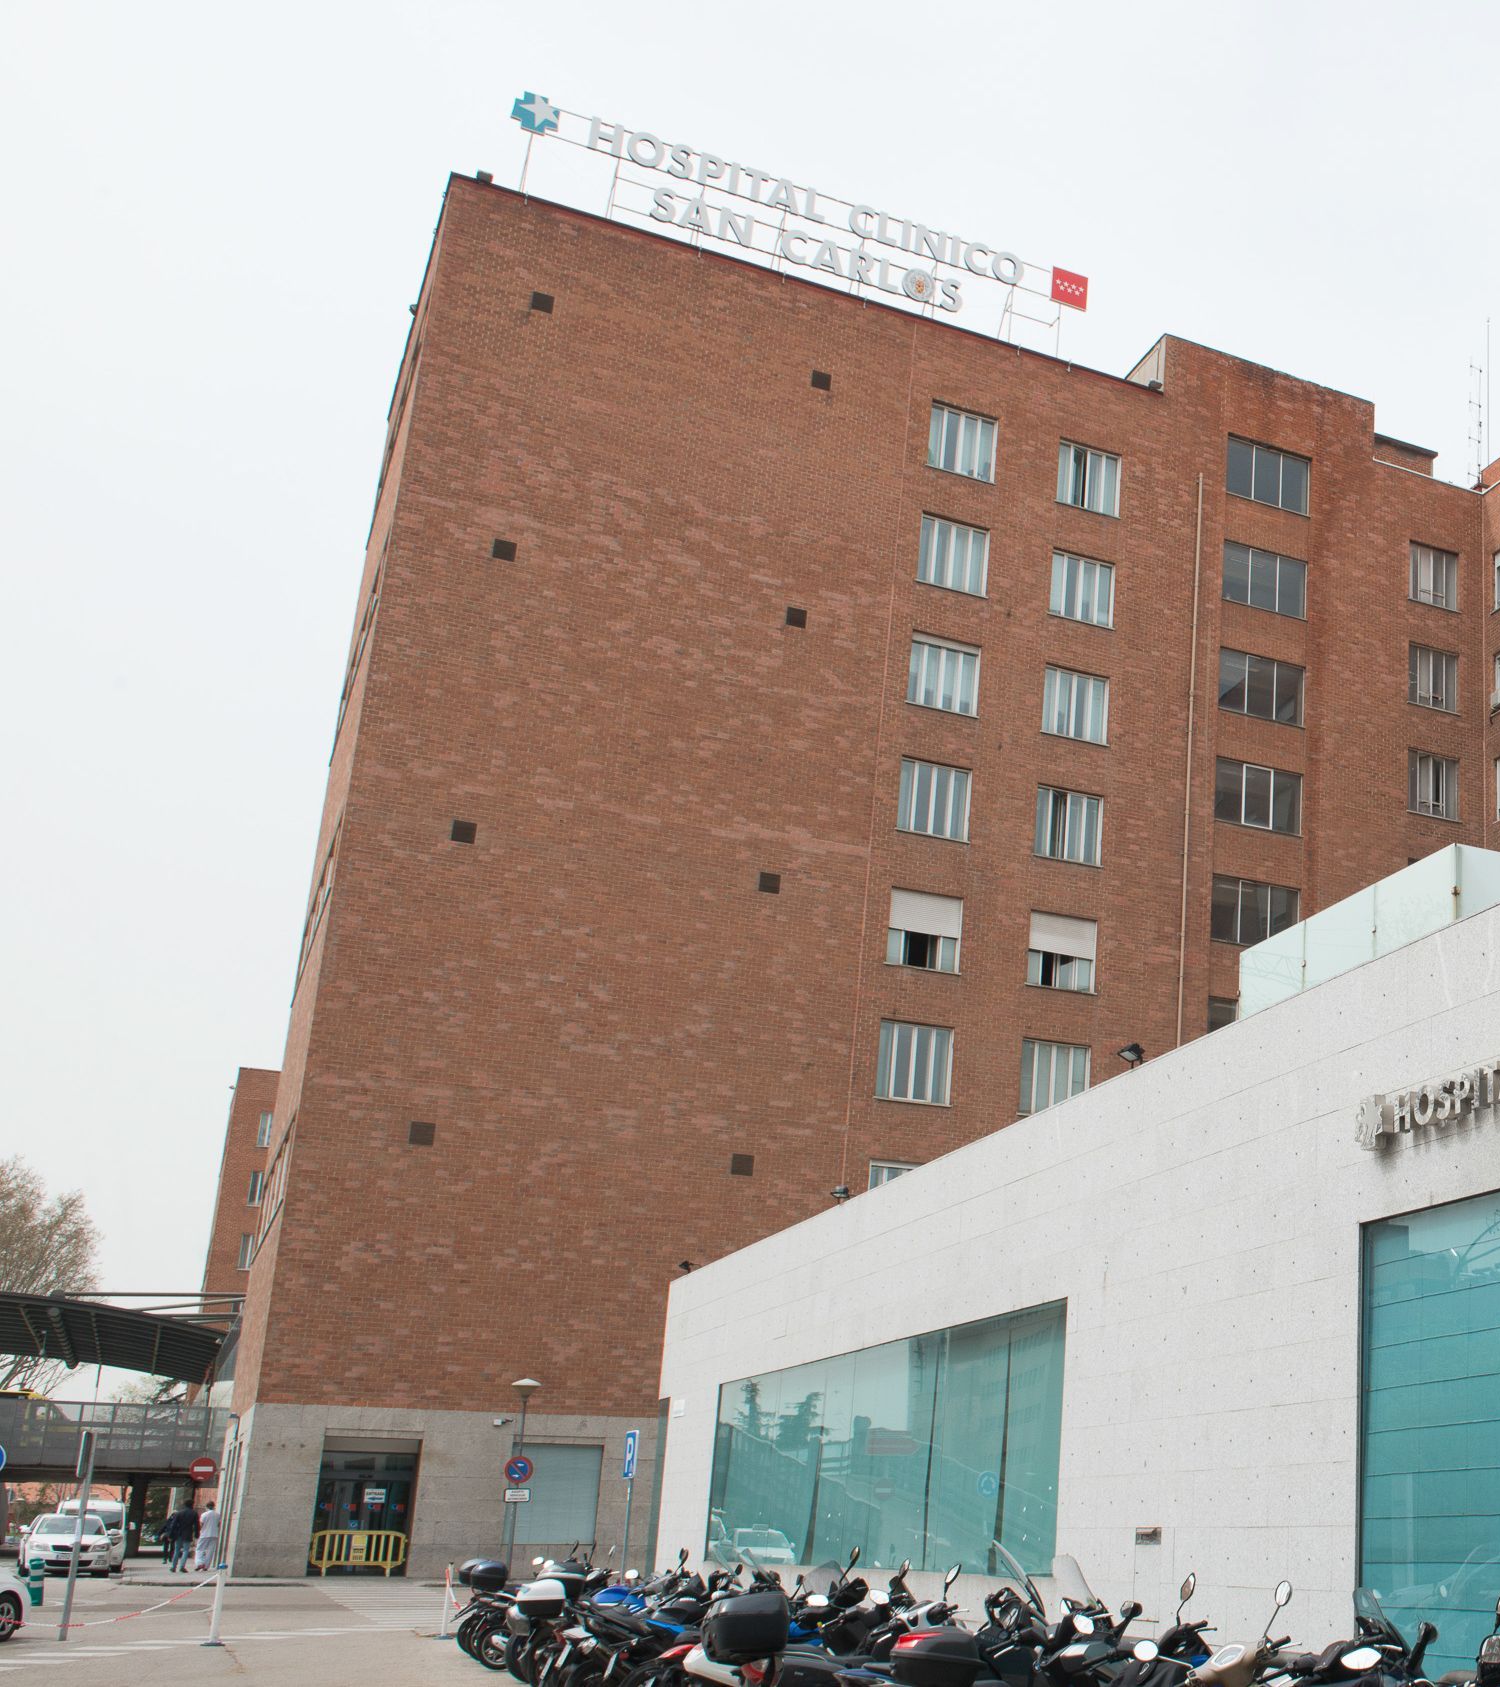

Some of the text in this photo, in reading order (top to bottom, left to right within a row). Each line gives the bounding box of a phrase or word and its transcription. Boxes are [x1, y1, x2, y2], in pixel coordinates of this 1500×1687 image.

[587, 116, 1025, 285] HOSPITAL CLINICO
[649, 187, 963, 313] SAN CARLOS
[625, 1437, 634, 1473] P
